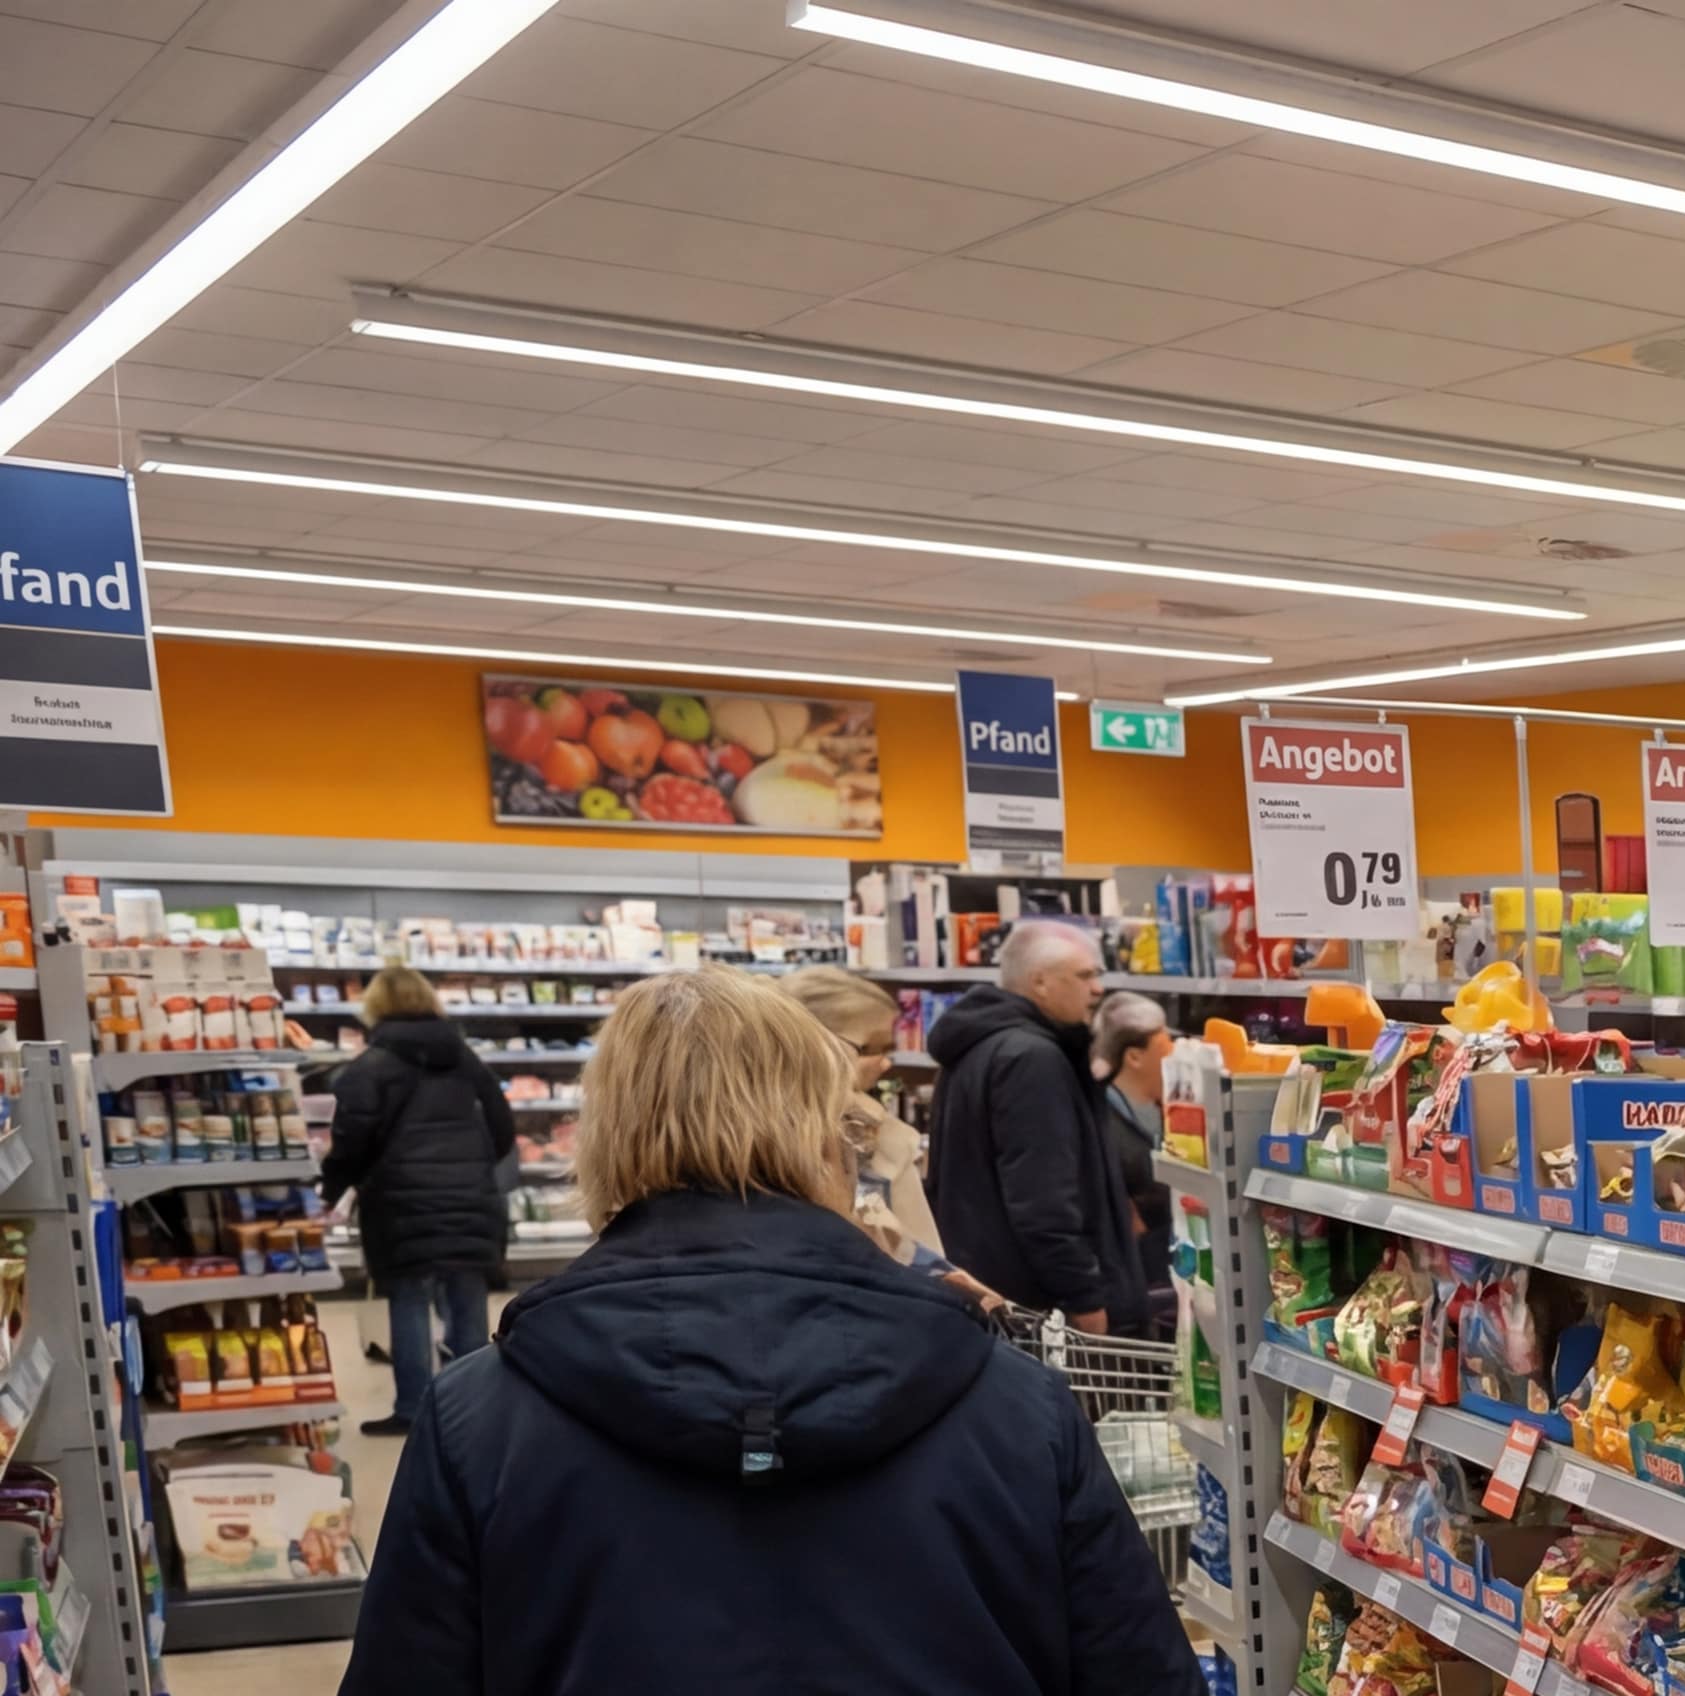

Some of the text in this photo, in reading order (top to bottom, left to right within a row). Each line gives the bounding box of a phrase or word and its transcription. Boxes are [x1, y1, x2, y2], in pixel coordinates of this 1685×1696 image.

[0, 551, 131, 610] fand
[969, 720, 1051, 757] Pfand
[1259, 736, 1397, 780] Angebot
